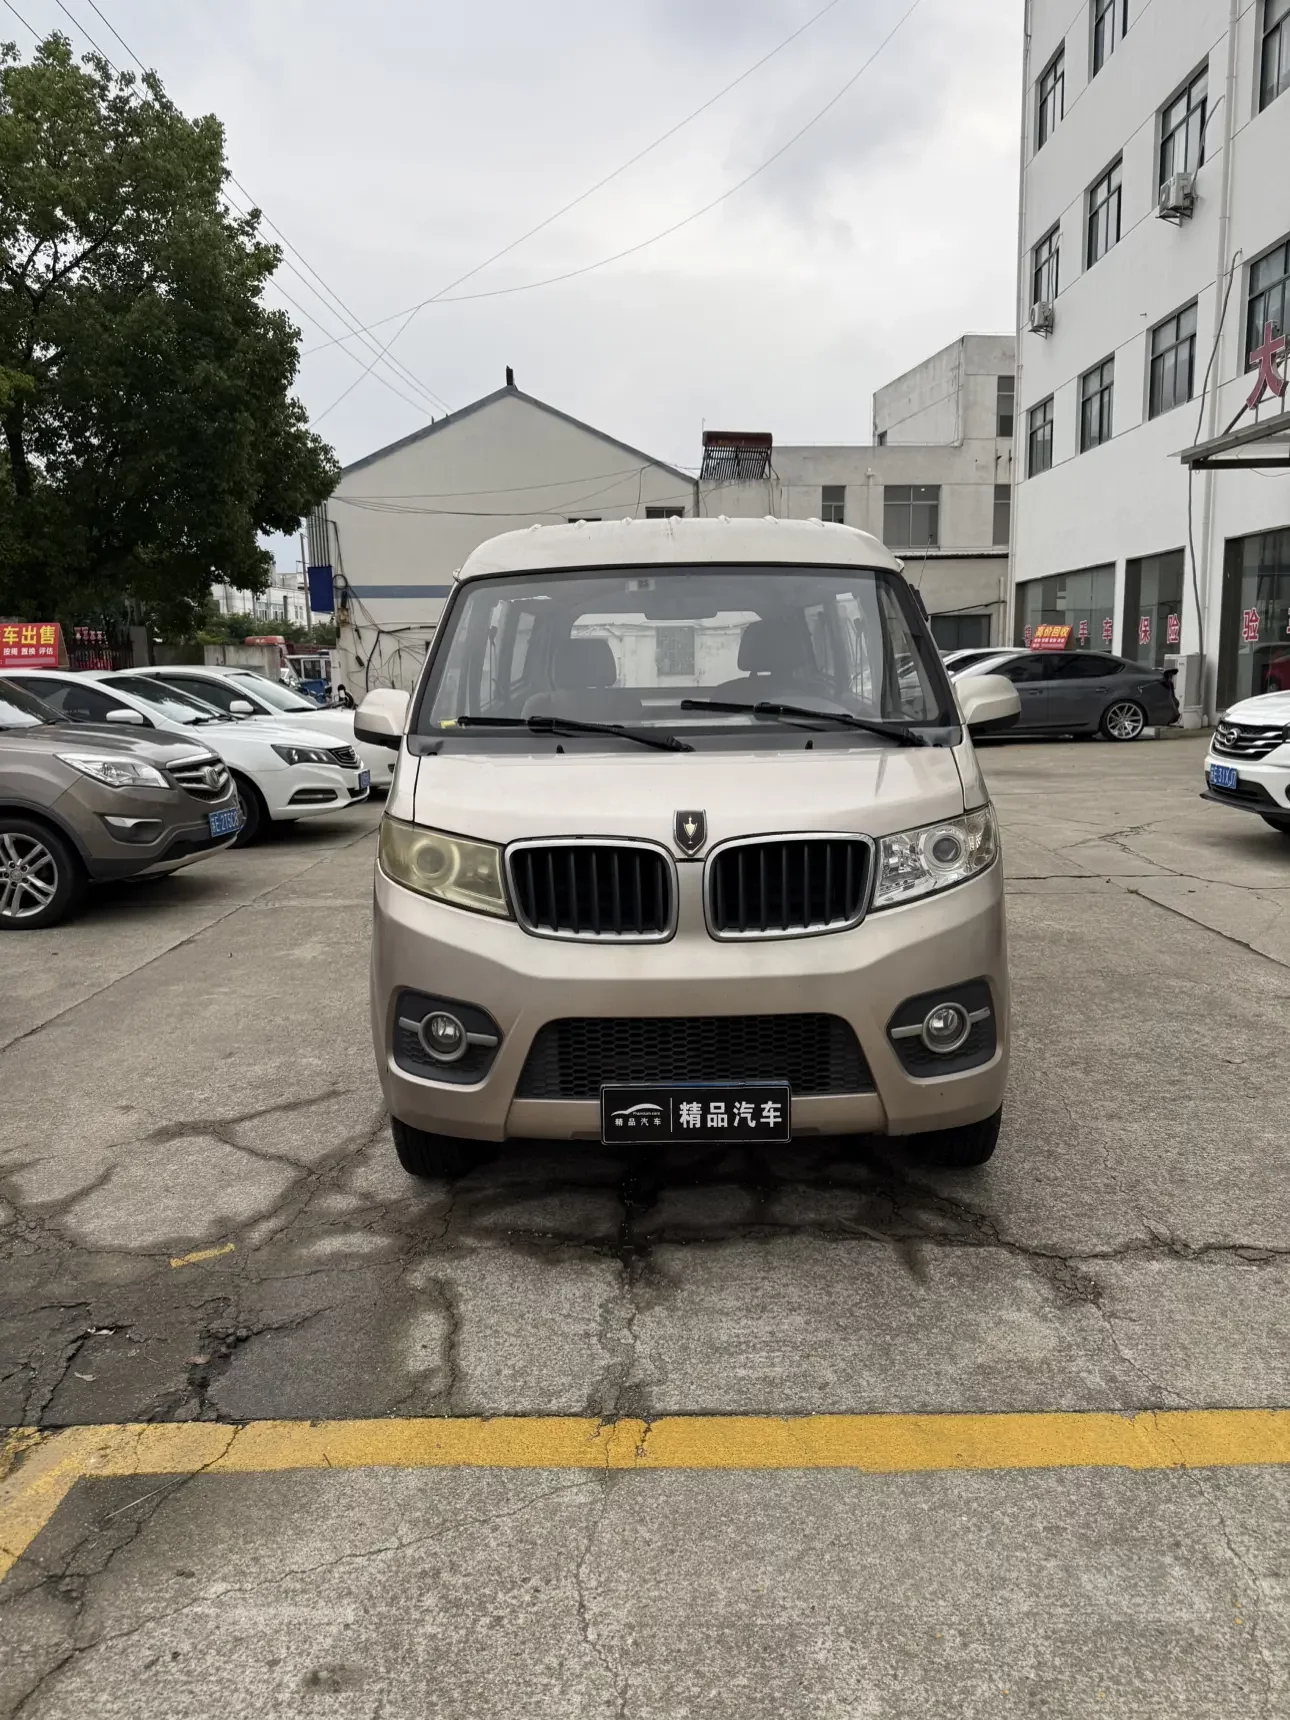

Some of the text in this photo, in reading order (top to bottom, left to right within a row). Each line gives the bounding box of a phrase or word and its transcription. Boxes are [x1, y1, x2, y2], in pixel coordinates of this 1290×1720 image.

[1246, 320, 1286, 410] 大
[0, 625, 56, 645] 车出售
[1035, 626, 1070, 638] 高价回收
[1139, 614, 1180, 644] 保险
[614, 1117, 662, 1127] 精品汽车
[679, 1101, 782, 1129] 精品汽车
